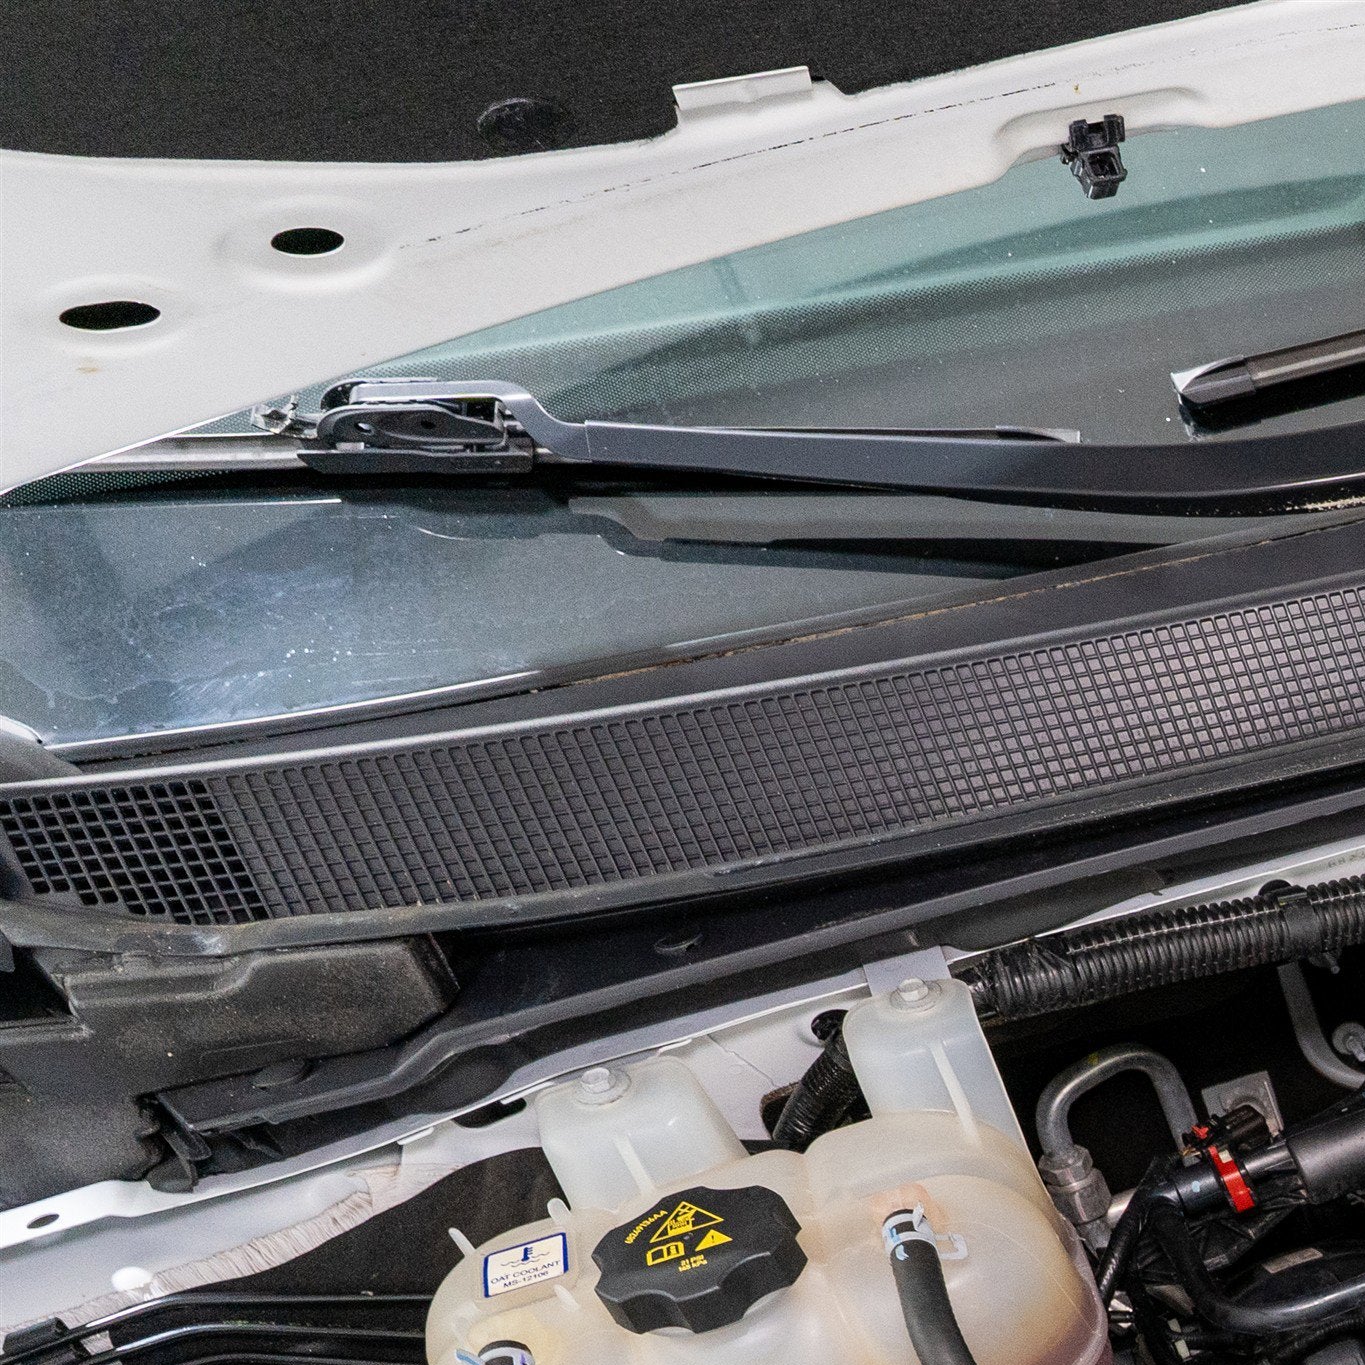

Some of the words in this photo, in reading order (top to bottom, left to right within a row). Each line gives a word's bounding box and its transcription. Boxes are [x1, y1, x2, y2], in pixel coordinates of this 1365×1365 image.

[490, 1272, 511, 1285] OAT
[512, 1259, 561, 1279] COOLANT
[502, 1270, 550, 1289] MS-12106
